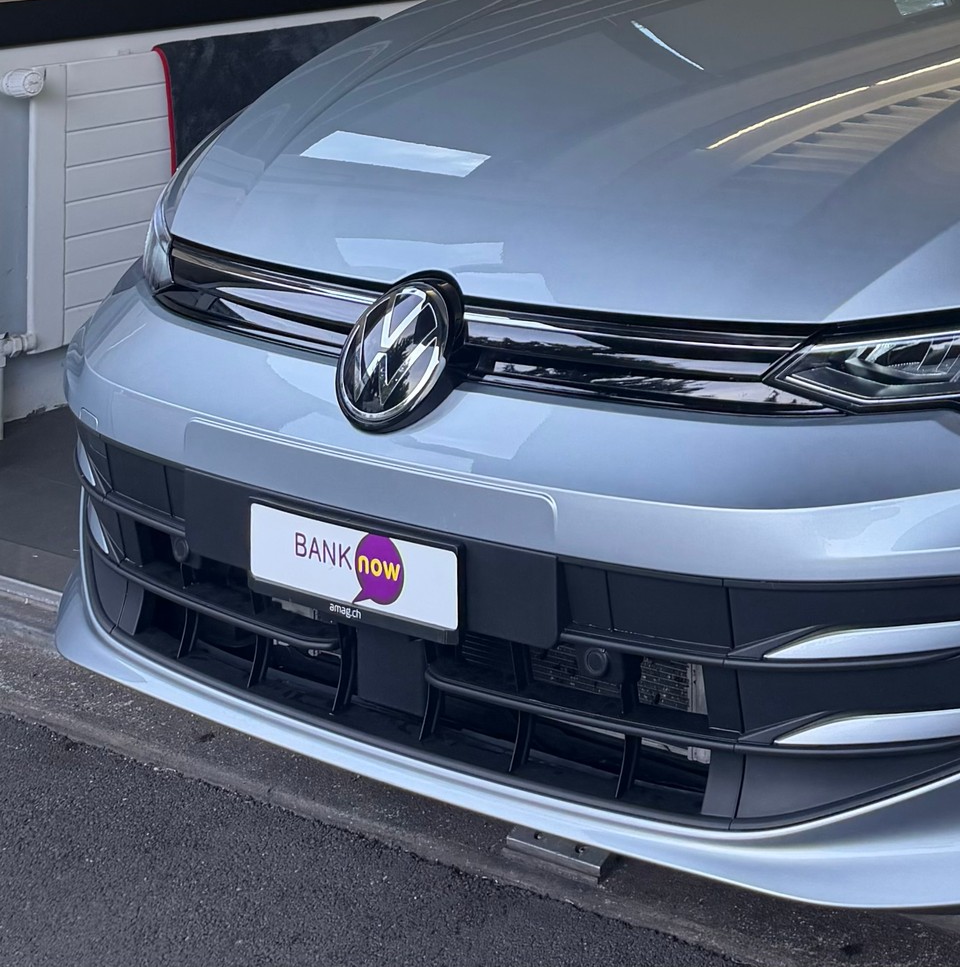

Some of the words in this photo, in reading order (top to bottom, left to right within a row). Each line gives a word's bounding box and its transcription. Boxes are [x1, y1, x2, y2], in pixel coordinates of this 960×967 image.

[295, 532, 352, 570] BANK
[358, 555, 401, 581] now
[329, 603, 362, 619] amag.ch
